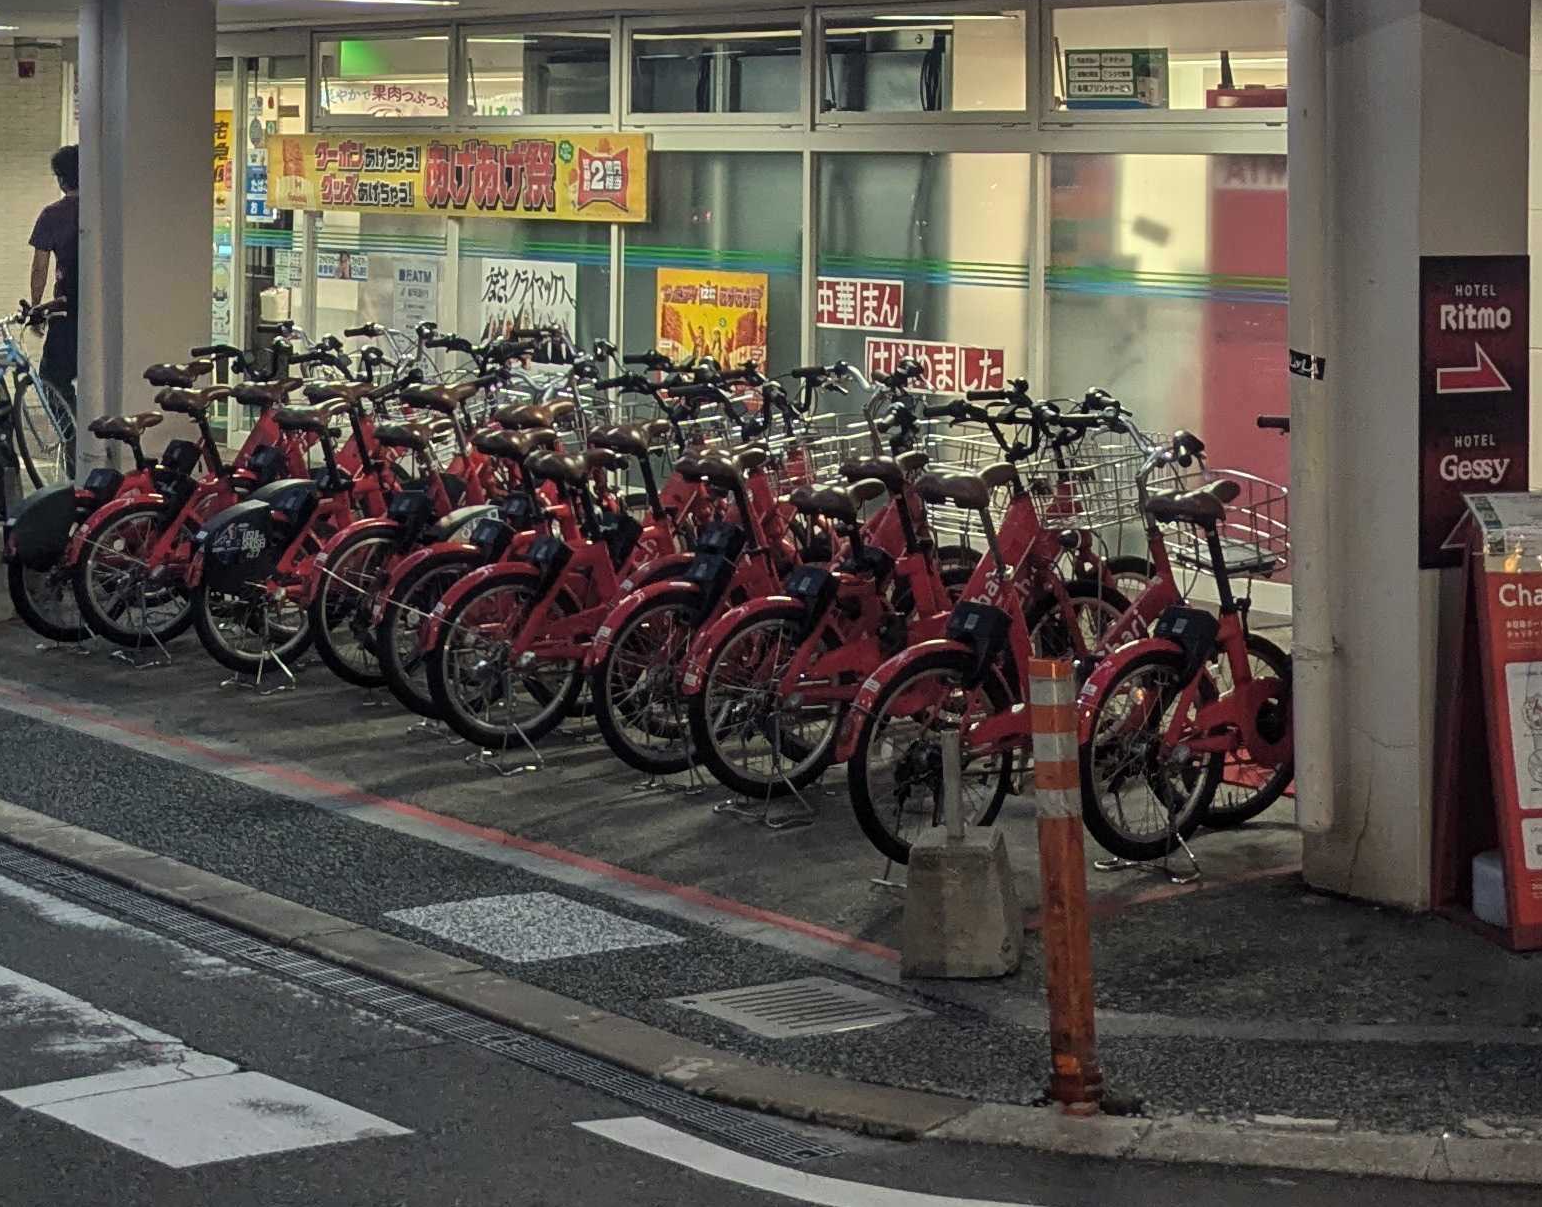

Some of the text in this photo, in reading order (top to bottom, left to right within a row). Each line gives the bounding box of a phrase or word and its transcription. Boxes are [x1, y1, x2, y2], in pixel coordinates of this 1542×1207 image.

[818, 281, 899, 327] 中華まん
[1455, 284, 1497, 297] HOTEL
[1440, 303, 1512, 331] Ritmo
[1454, 434, 1496, 448] HOTEL
[1439, 454, 1511, 484] Gessy
